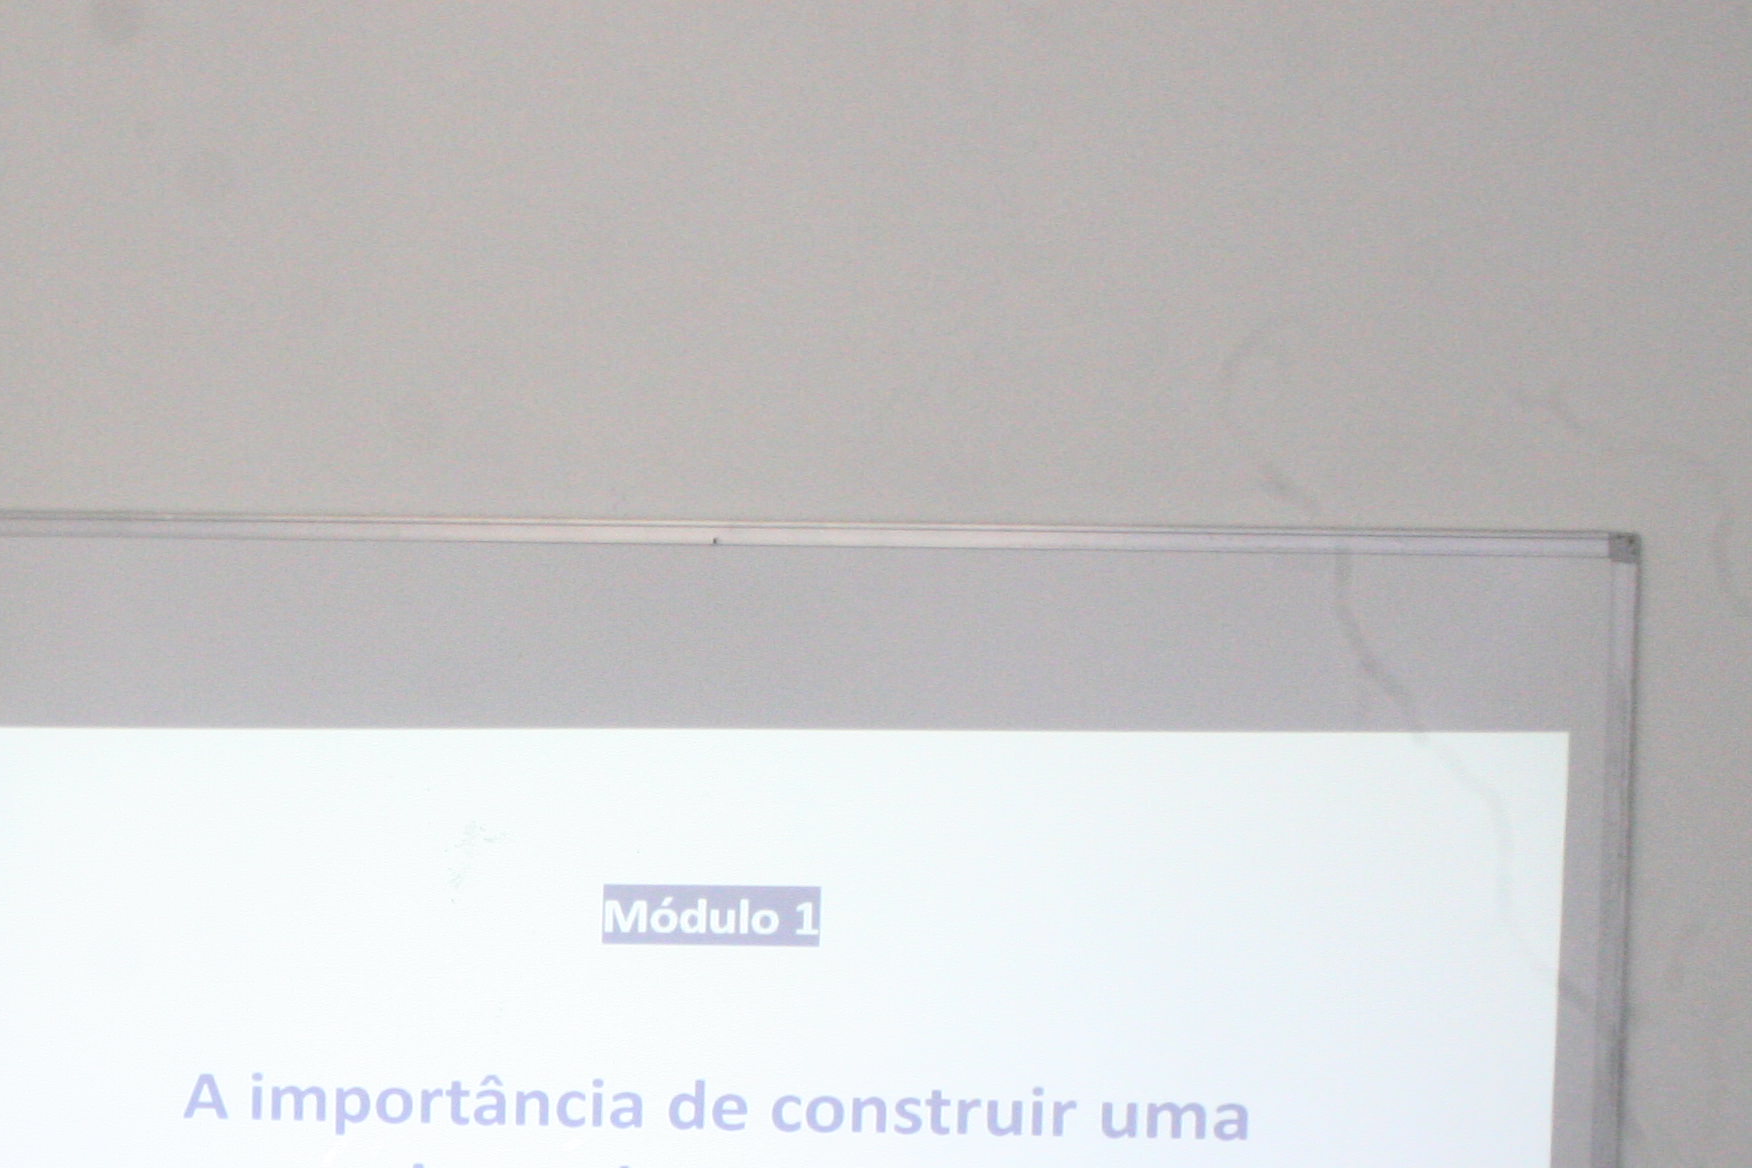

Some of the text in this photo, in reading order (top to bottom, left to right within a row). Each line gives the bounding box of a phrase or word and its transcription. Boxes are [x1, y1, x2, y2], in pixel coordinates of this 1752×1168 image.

[604, 896, 819, 935] Módulo 1
[183, 1071, 1249, 1142] A importância de construir uma
